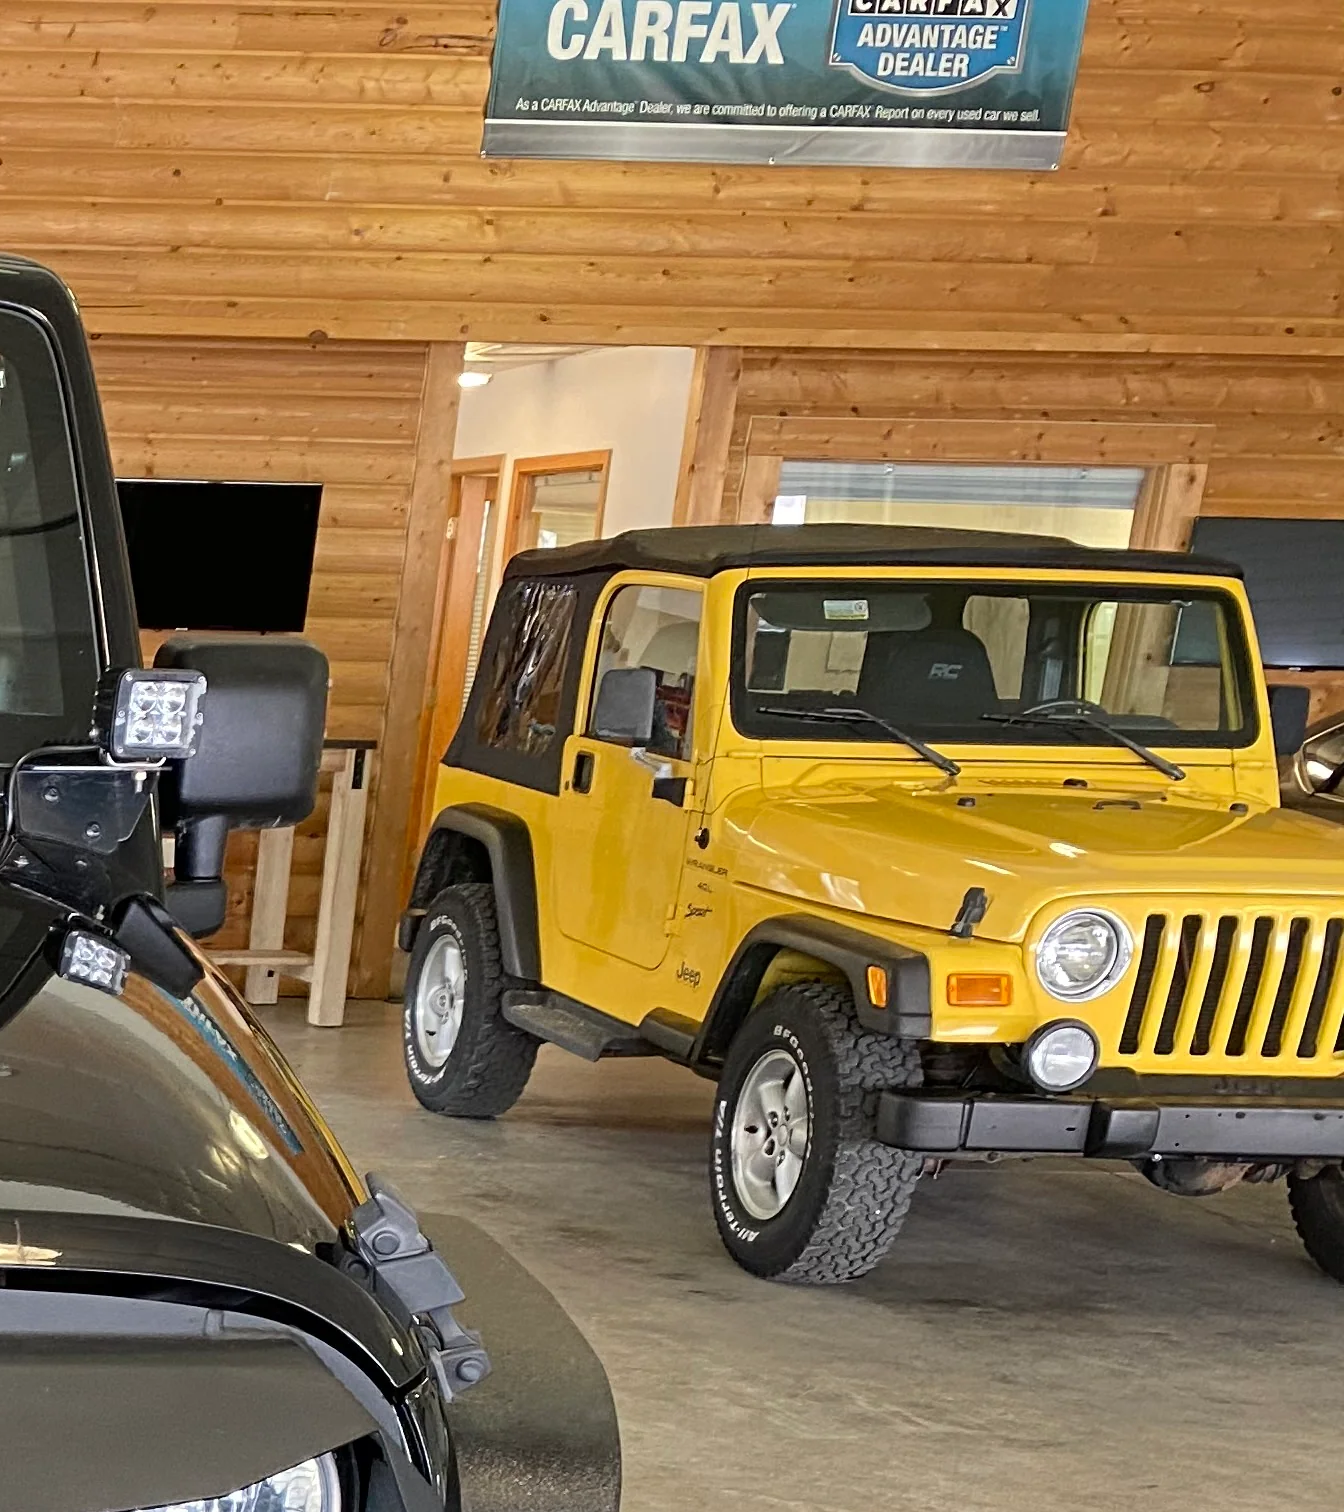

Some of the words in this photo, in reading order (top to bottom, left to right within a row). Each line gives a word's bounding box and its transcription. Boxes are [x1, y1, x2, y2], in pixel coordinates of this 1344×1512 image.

[547, 0, 792, 64] CARFAX
[857, 23, 999, 49] ADVANTAGE
[877, 52, 970, 78] DEALER
[516, 97, 529, 111] As
[531, 101, 539, 111] a
[540, 98, 582, 112] CARFAX
[582, 99, 635, 115] Advantage
[639, 101, 673, 115] Dealer,
[676, 104, 691, 115] we
[693, 103, 710, 115] are
[712, 103, 764, 117] committed
[766, 104, 777, 117] to
[778, 104, 817, 120] offering
[819, 107, 827, 118] a
[829, 105, 871, 119] CARFAX
[875, 105, 909, 120] Report
[911, 108, 925, 120] on
[927, 108, 955, 123] every
[957, 108, 983, 121] used
[984, 110, 1000, 121] car
[1003, 111, 1018, 122] we
[928, 663, 962, 680] RC
[676, 960, 701, 988] Jeep
